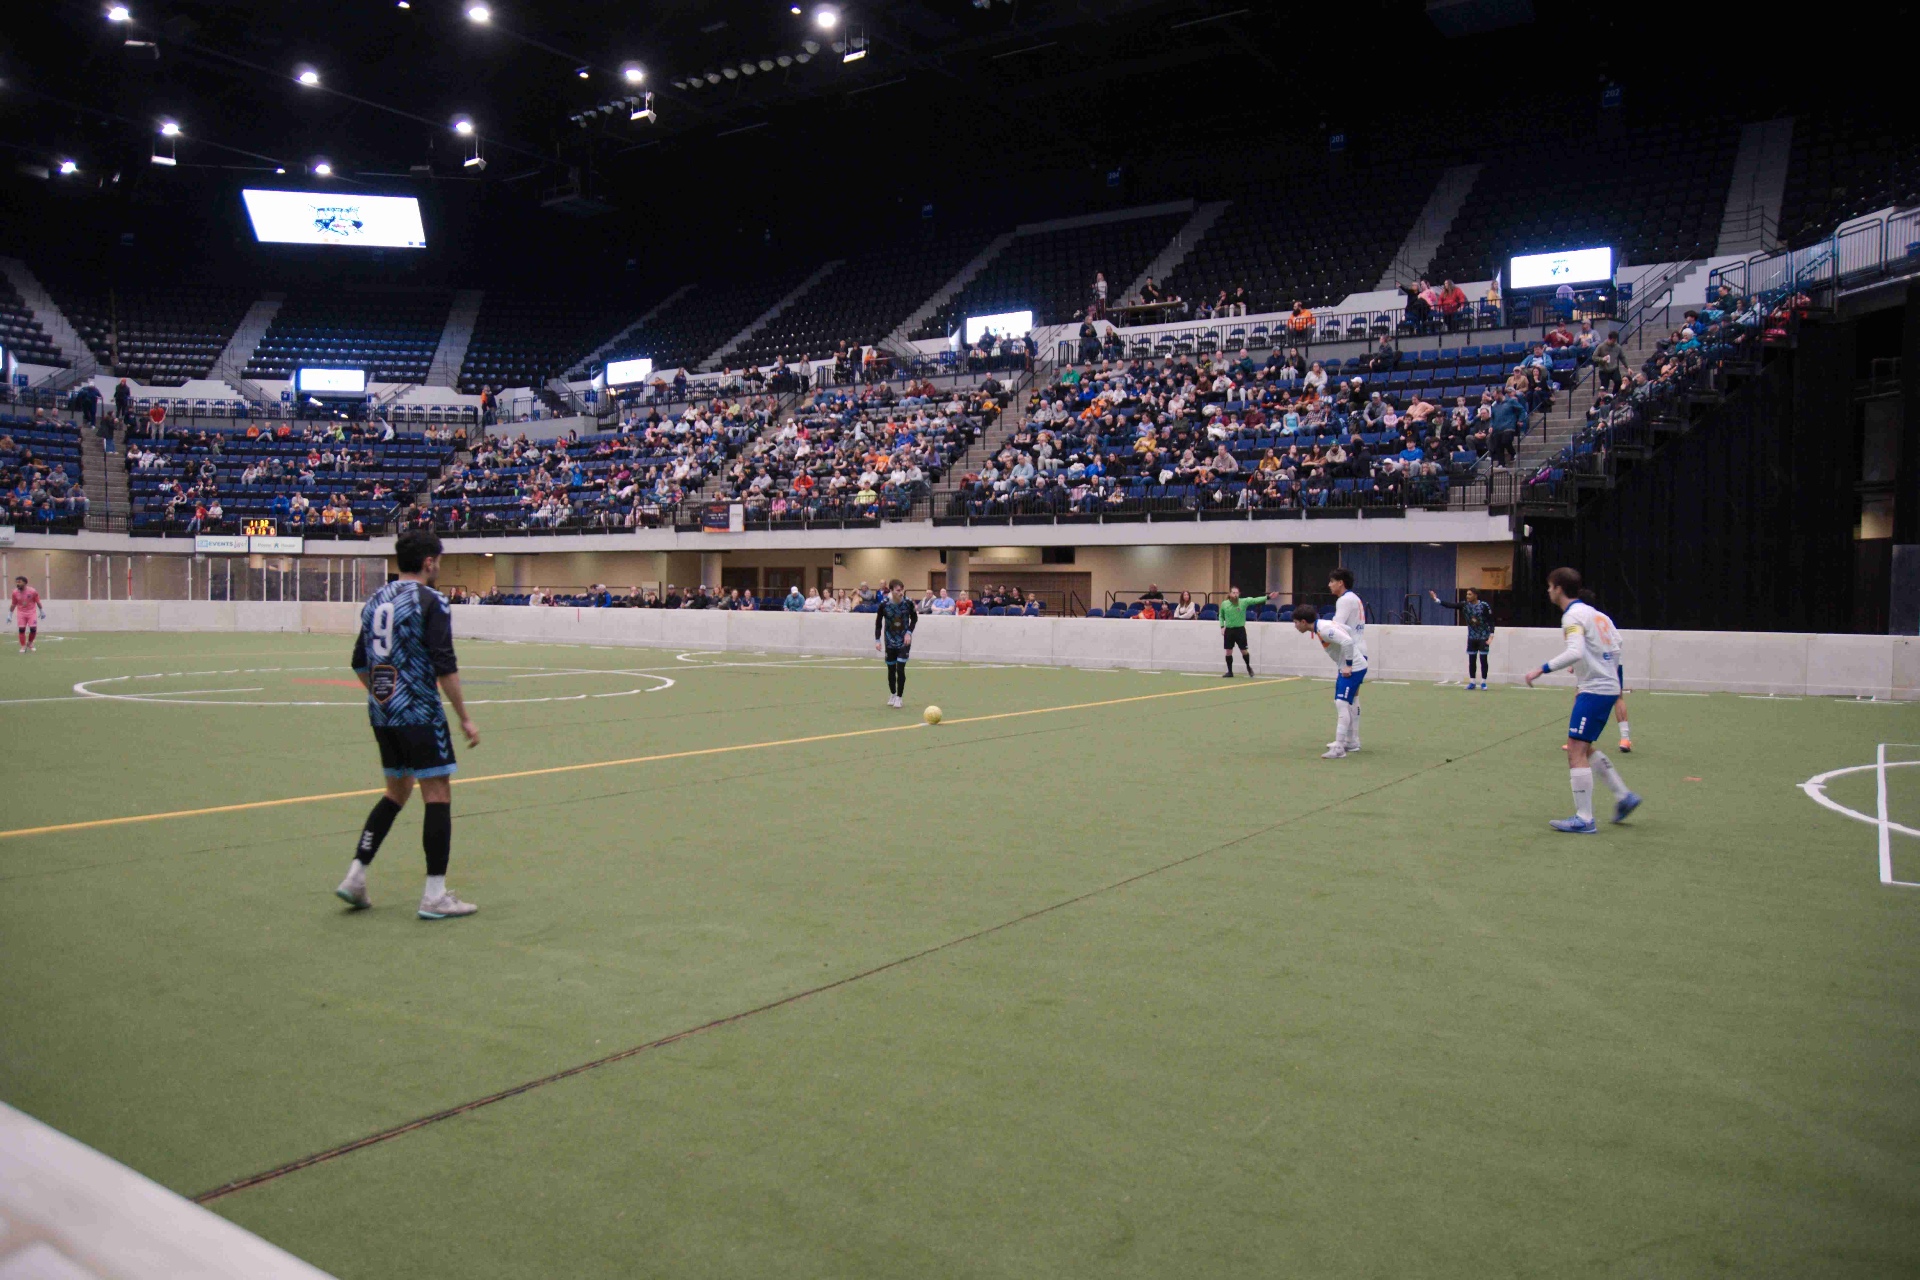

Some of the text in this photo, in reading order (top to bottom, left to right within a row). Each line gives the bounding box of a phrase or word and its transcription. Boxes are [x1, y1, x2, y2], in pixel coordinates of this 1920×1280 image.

[1605, 88, 1620, 98] 202
[1331, 134, 1344, 144] 203
[373, 602, 395, 657] 9
